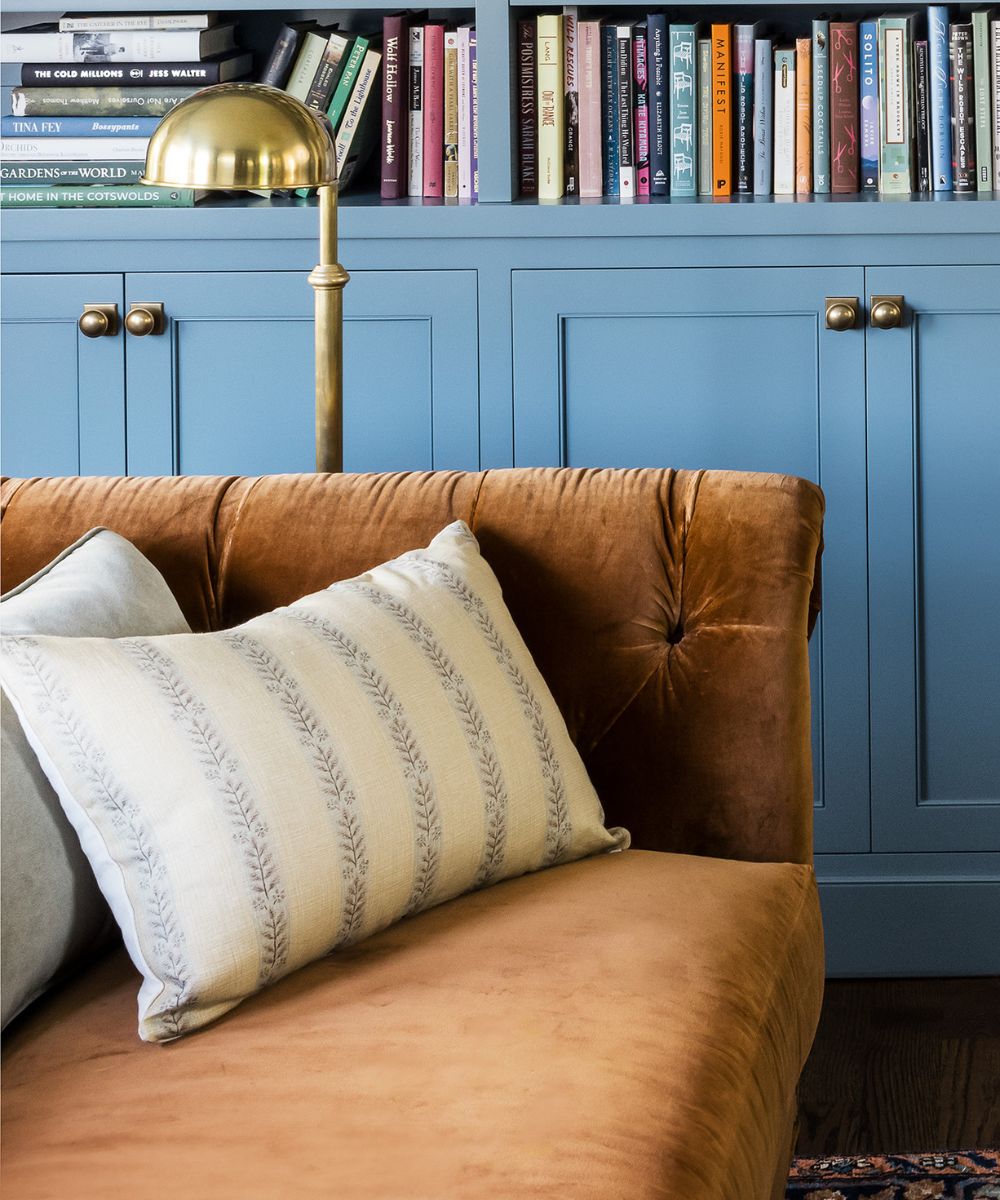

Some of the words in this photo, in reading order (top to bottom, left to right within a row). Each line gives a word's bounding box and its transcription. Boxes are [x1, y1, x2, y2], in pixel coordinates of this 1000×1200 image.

[387, 37, 398, 61] Wolf
[864, 34, 873, 86] SOLITO
[386, 64, 397, 103] Hollow
[521, 42, 534, 114] POSTMISTRESS
[716, 39, 726, 114] MANIFEST
[13, 123, 39, 132] TINA
[41, 122, 62, 132] FEY
[92, 122, 139, 133] Bossypants
[522, 118, 535, 151] SARAH
[78, 168, 126, 177] WORLD
[523, 154, 535, 182] BLAKE
[9, 192, 44, 201] HOME
[87, 192, 159, 200] COTSWOLDS
